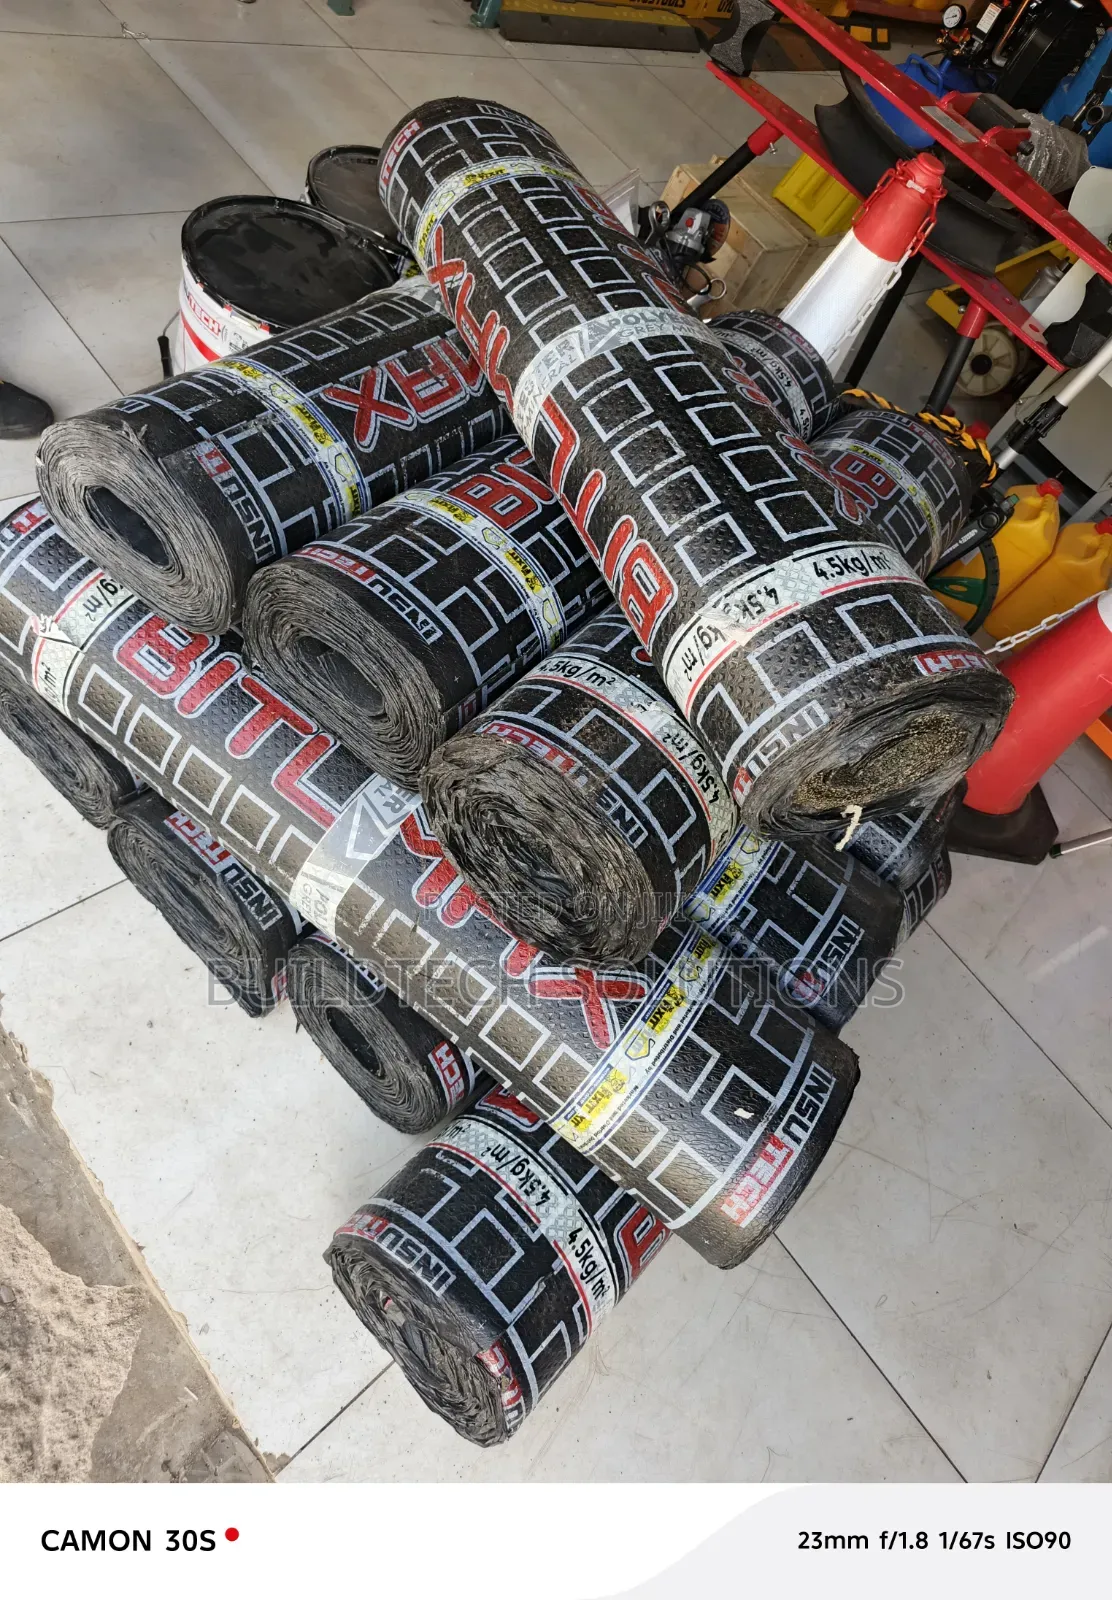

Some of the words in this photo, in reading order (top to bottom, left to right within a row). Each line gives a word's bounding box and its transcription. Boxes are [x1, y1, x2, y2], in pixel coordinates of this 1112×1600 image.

[809, 552, 895, 581] 4.5kg/m²
[297, 547, 444, 645] INSUTECH
[539, 655, 616, 688] 4.5kg/m²
[662, 733, 720, 804] 4.5kg/m²
[163, 809, 282, 931] INSUTECH
[645, 998, 671, 1030] FIXIT
[679, 999, 697, 1024] Marketed
[671, 1023, 682, 1035] and
[650, 1033, 675, 1066] Distributed
[643, 1064, 653, 1075] by
[582, 1085, 609, 1113] FIXIT
[616, 1084, 639, 1111] Marketed
[720, 1063, 836, 1229] INSUTECH
[486, 1142, 551, 1207] 4.5kg/m²
[568, 1227, 612, 1300] 4.5kg/m²
